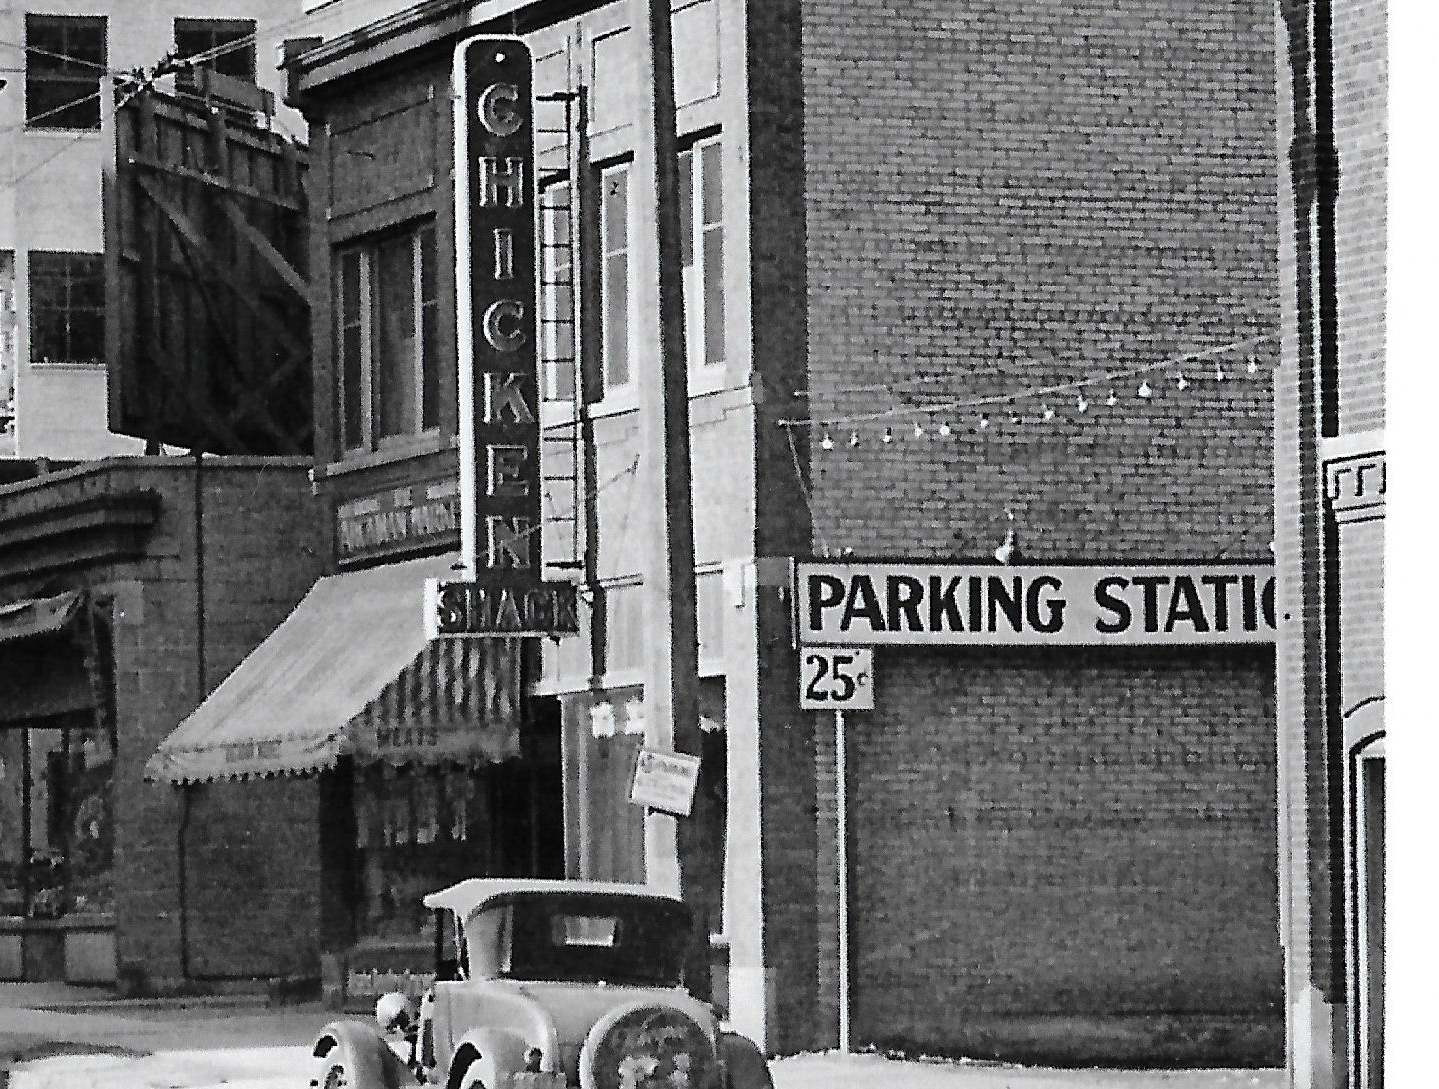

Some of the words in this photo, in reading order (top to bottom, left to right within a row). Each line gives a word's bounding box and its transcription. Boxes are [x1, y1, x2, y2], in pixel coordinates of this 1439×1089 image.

[477, 82, 534, 569] CHICKEN
[437, 588, 578, 629] SHACK
[808, 574, 1067, 633] PARKING
